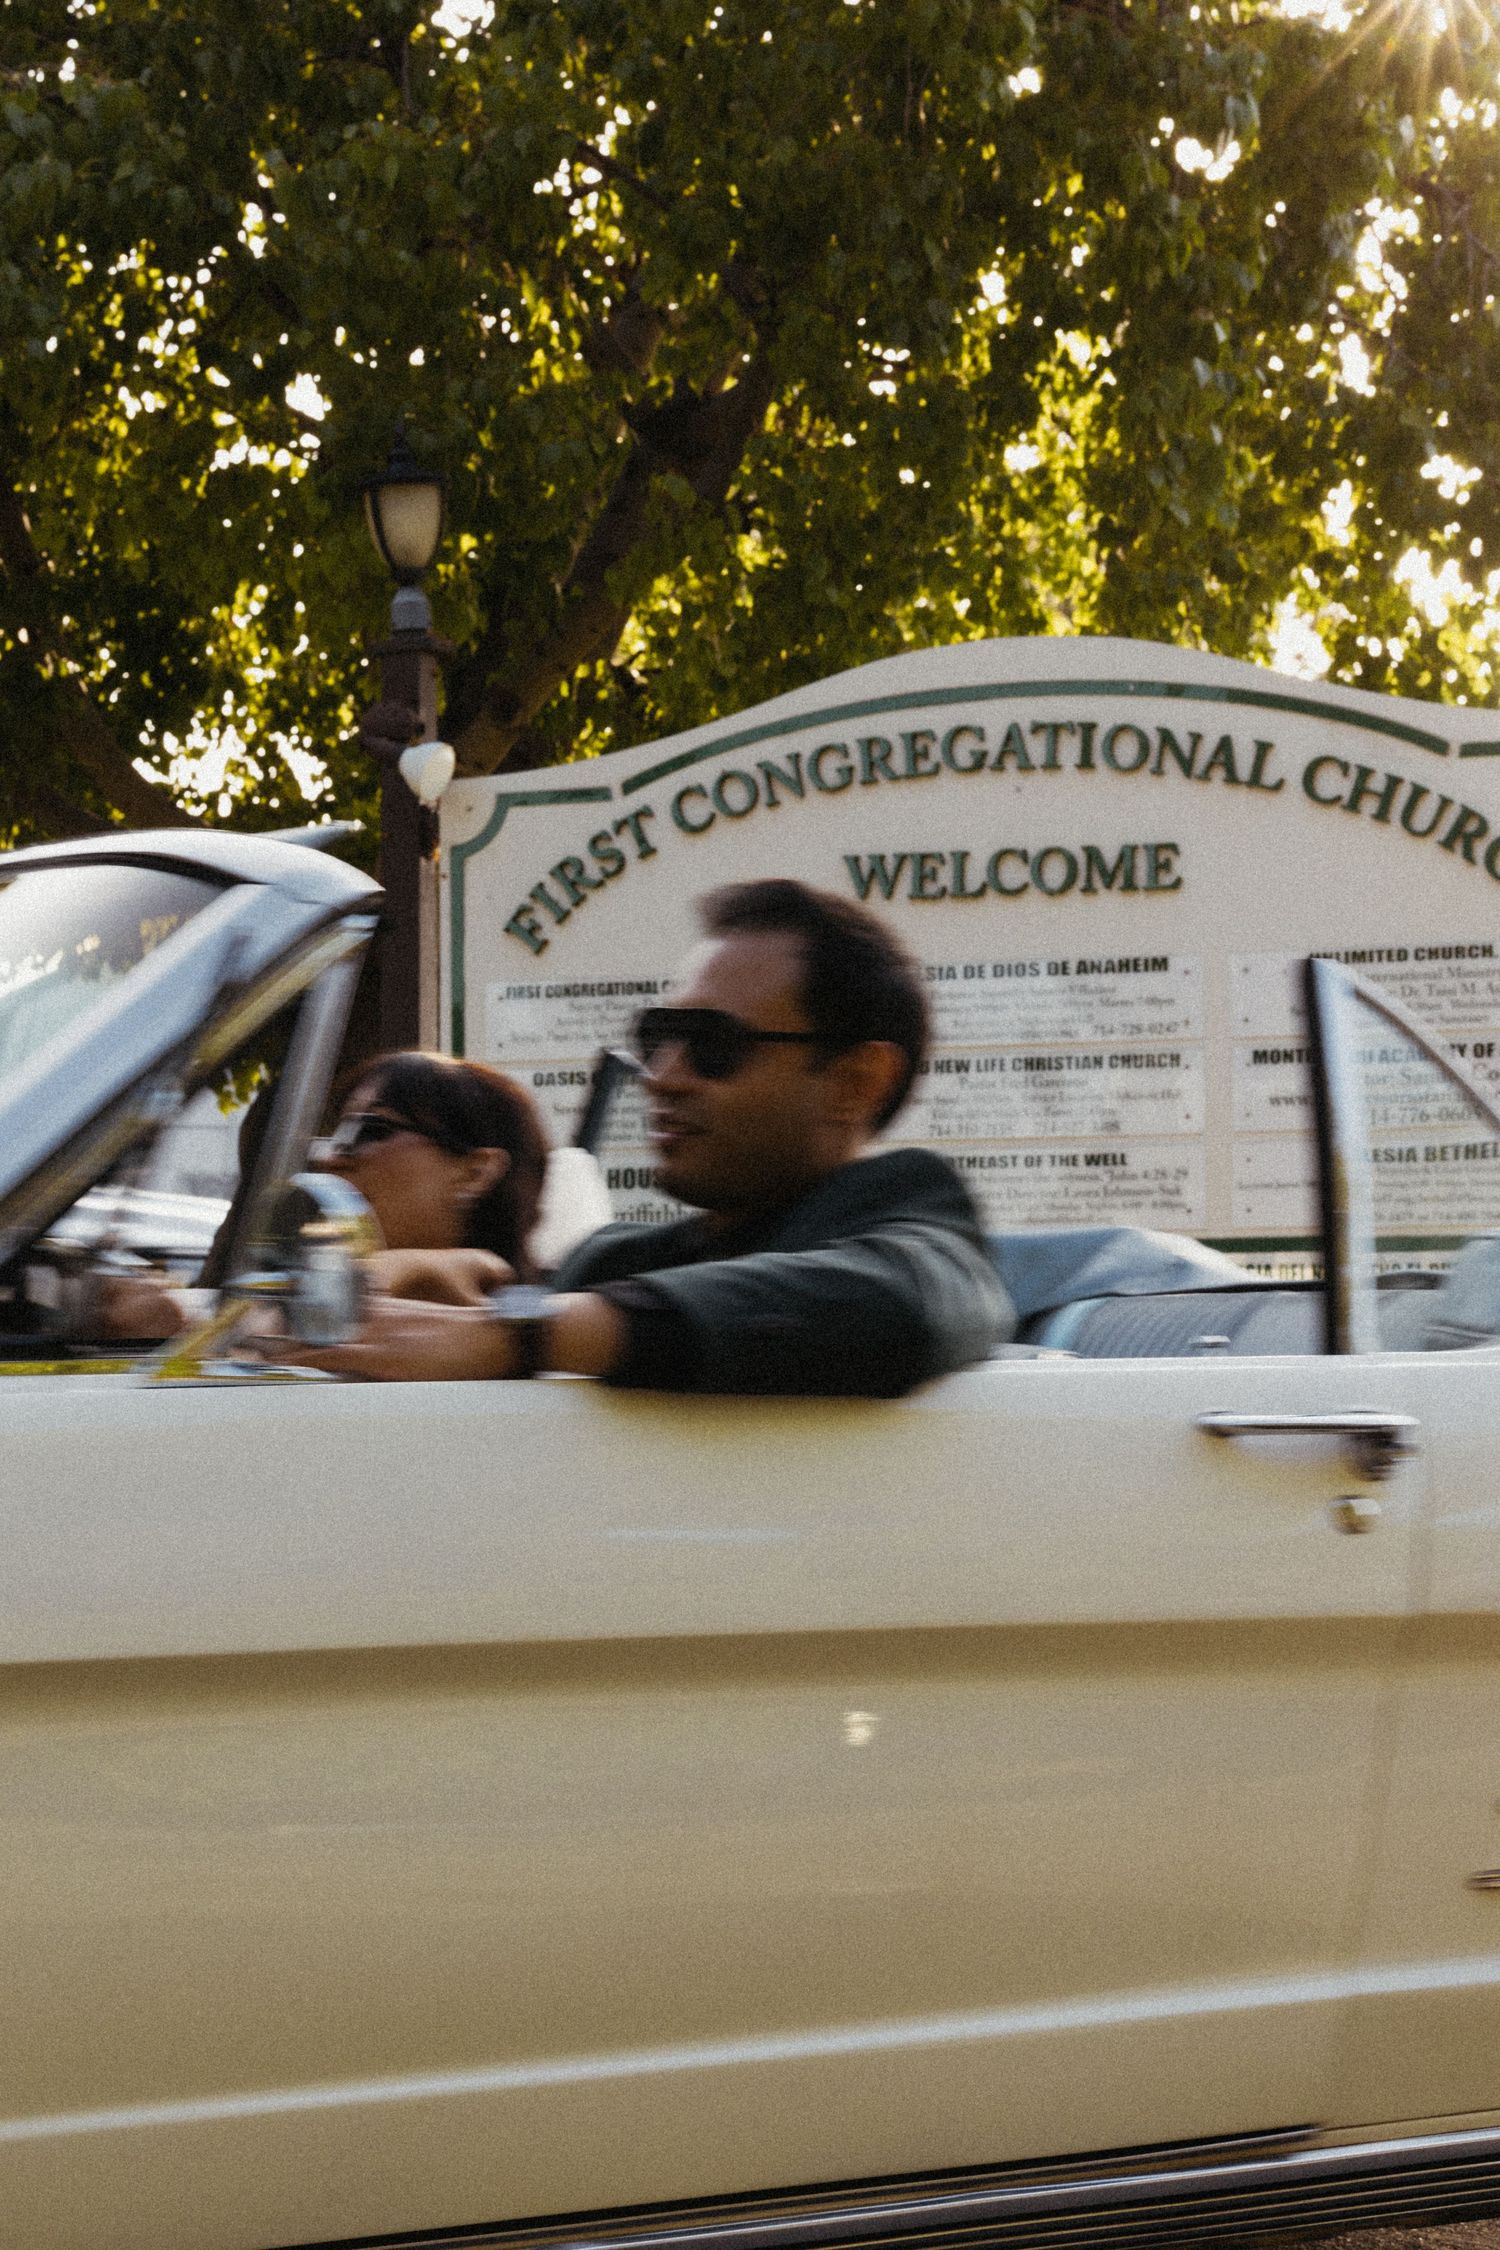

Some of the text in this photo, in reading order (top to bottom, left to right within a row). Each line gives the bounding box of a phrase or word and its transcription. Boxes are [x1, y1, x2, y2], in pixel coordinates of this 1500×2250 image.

[504, 805, 658, 955] FIRST
[670, 721, 1286, 834] CONGREGATIONAL
[843, 842, 1183, 901] WELCOME
[963, 963, 986, 979] DE
[992, 962, 1040, 978] DIOS
[1047, 960, 1072, 976] DE
[1075, 956, 1169, 975] ANAHEIM
[505, 984, 541, 1000] FIRST
[544, 980, 659, 999] CONGREGATIONAL
[1473, 1042, 1496, 1059] OF
[976, 1058, 1005, 1074] LIFE
[1011, 1055, 1103, 1073] CHRISTIAN
[1109, 1053, 1182, 1070] CHURCH
[533, 1071, 587, 1088] OASIS
[1024, 1154, 1043, 1169] OF
[1050, 1153, 1079, 1168] THE
[1084, 1152, 1129, 1167] WELL
[607, 1167, 653, 1190] HOU
